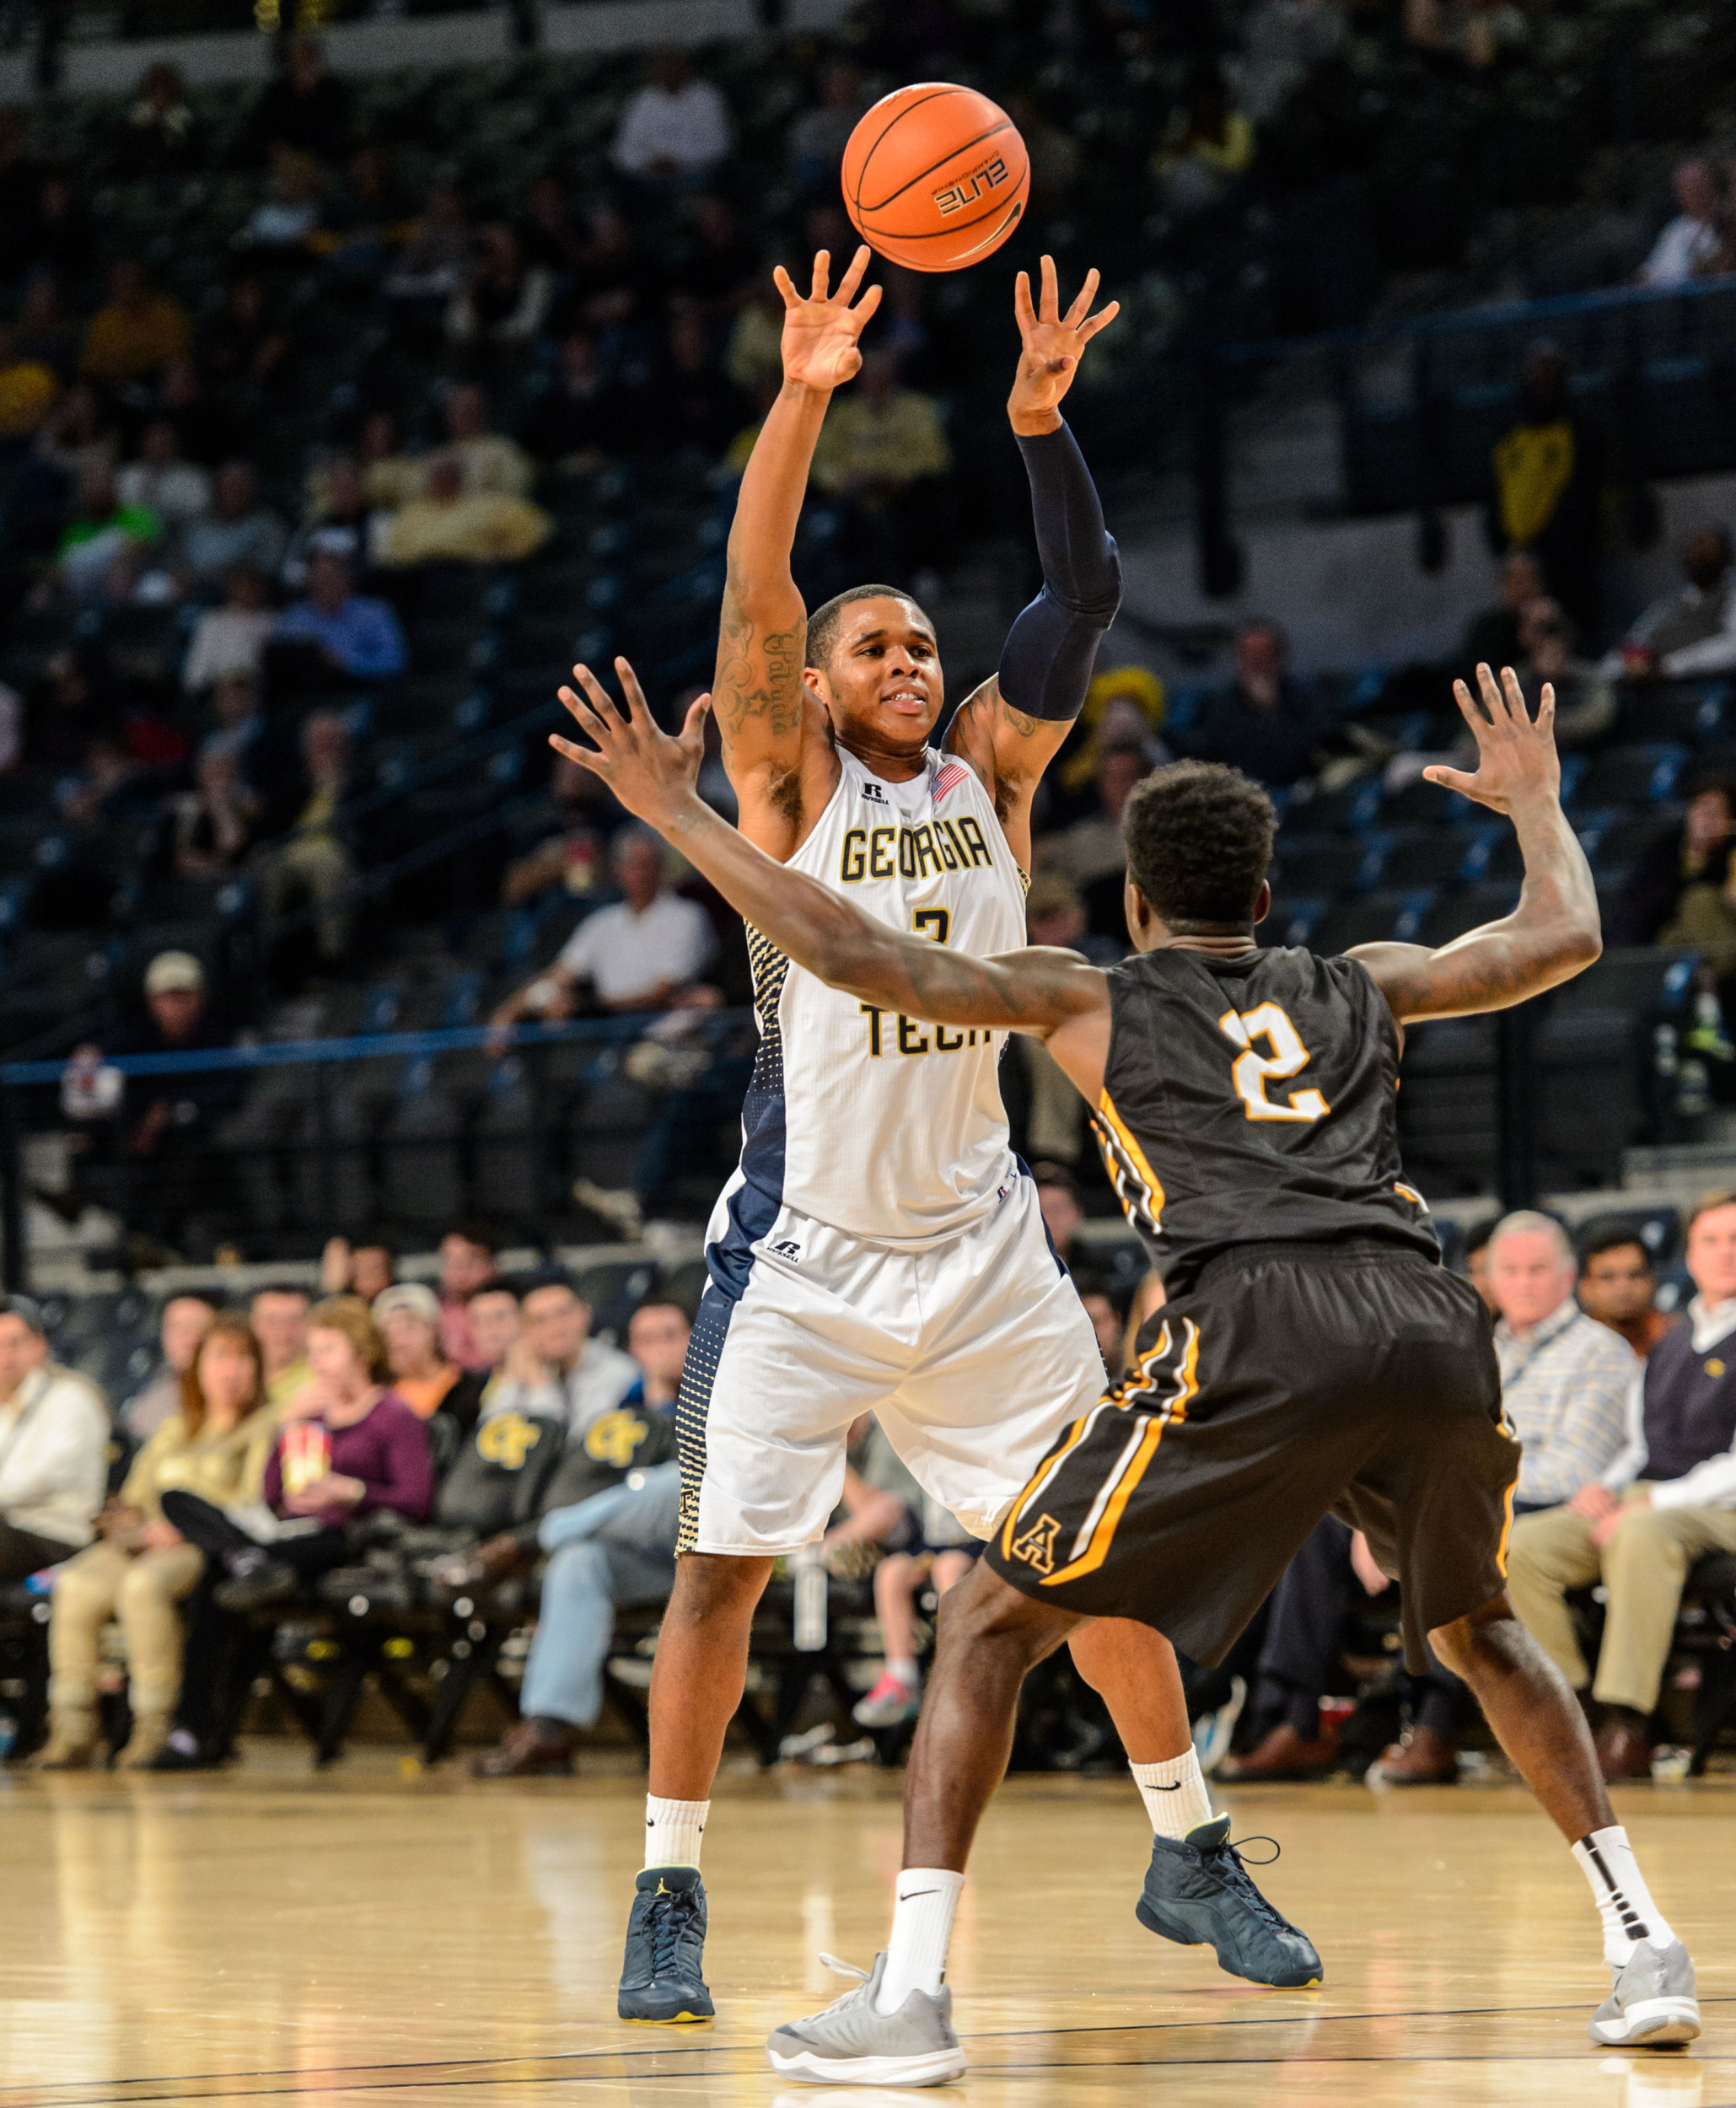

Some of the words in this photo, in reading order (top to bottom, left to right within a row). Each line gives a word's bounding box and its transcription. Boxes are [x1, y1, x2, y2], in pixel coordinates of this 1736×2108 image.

[934, 158, 1009, 217] ELITE
[861, 793, 889, 805] RUSSELL
[840, 815, 994, 883] GEORGIA
[1218, 1001, 1330, 1122] 2
[1012, 1513, 1062, 1575] A
